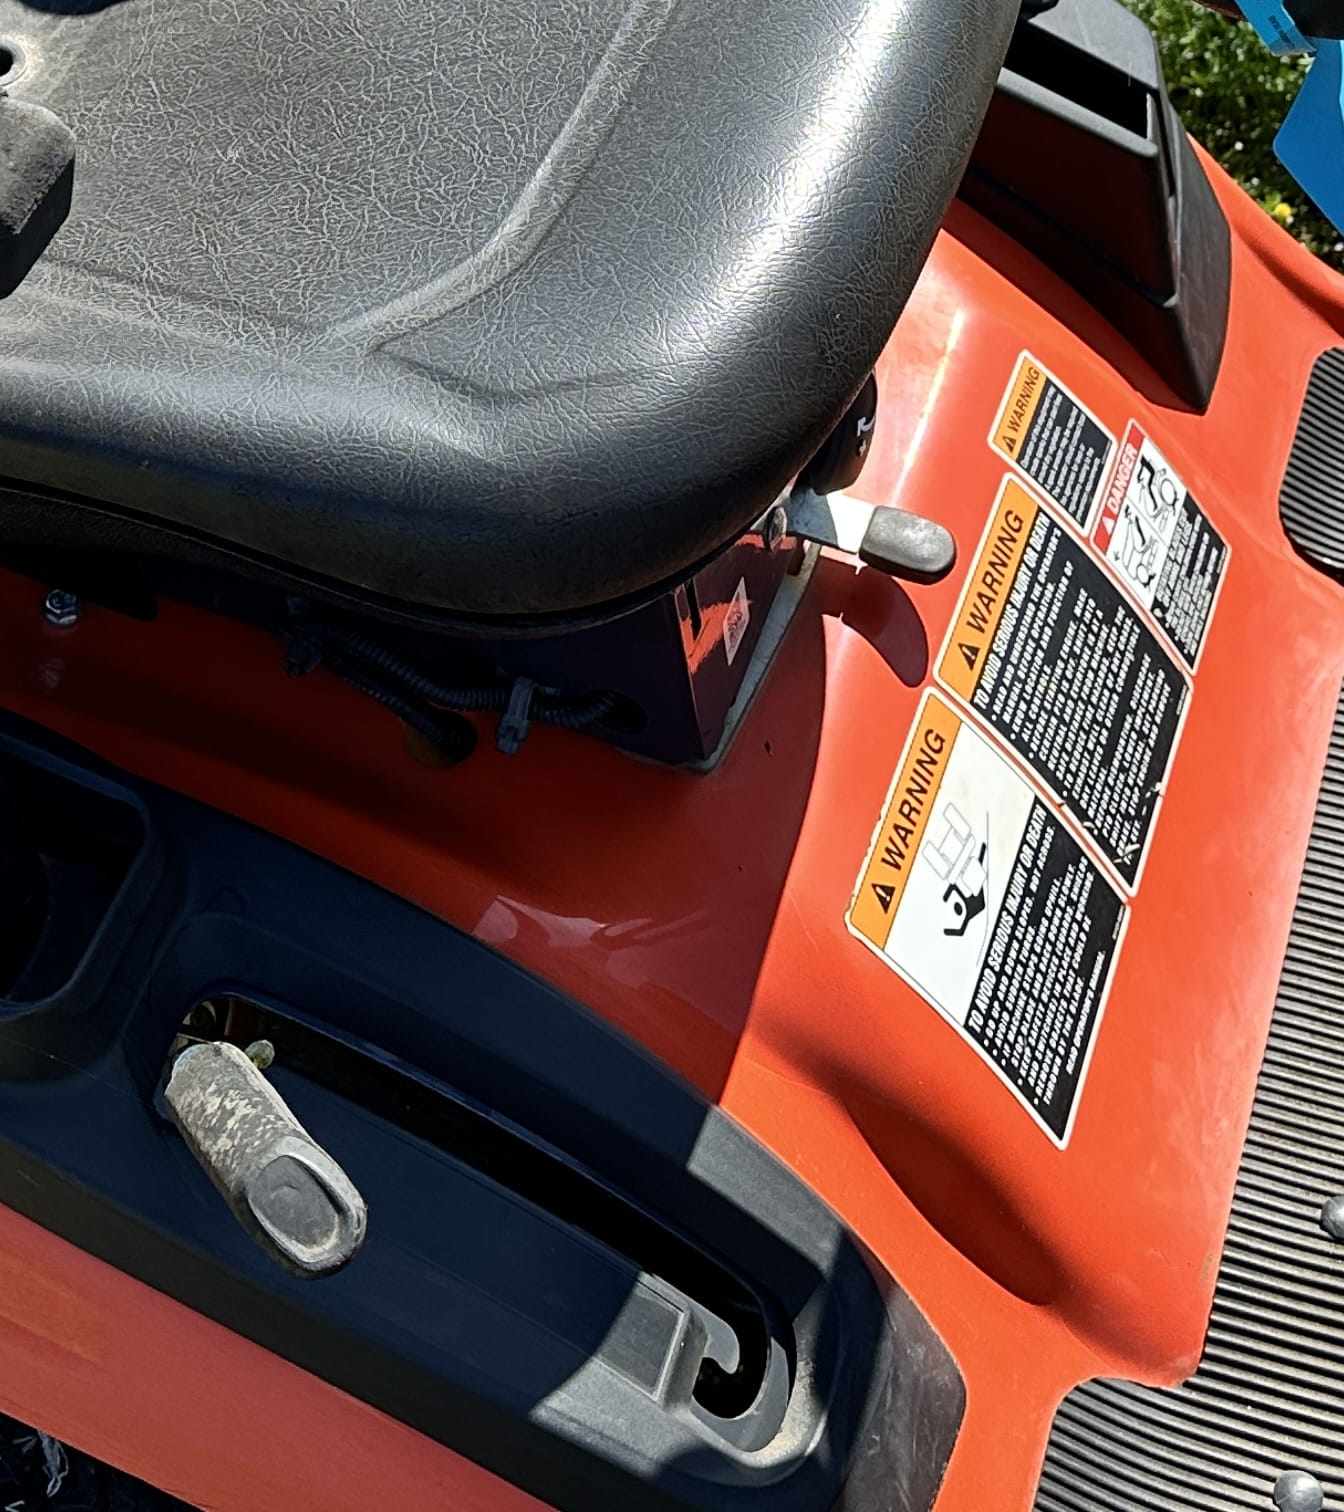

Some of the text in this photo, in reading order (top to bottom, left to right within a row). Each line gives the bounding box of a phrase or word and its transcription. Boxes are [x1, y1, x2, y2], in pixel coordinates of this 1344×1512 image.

[1008, 367, 1040, 433] WARNING
[1107, 444, 1137, 514] DANGER
[966, 510, 1023, 634] WARNING
[974, 512, 1050, 709] TO AVOID SERIOUS INJURY OR DEATH
[881, 729, 945, 871] WARNING
[968, 804, 1046, 1033] TO AVOID SERIOUS INJURY OR DEATH
